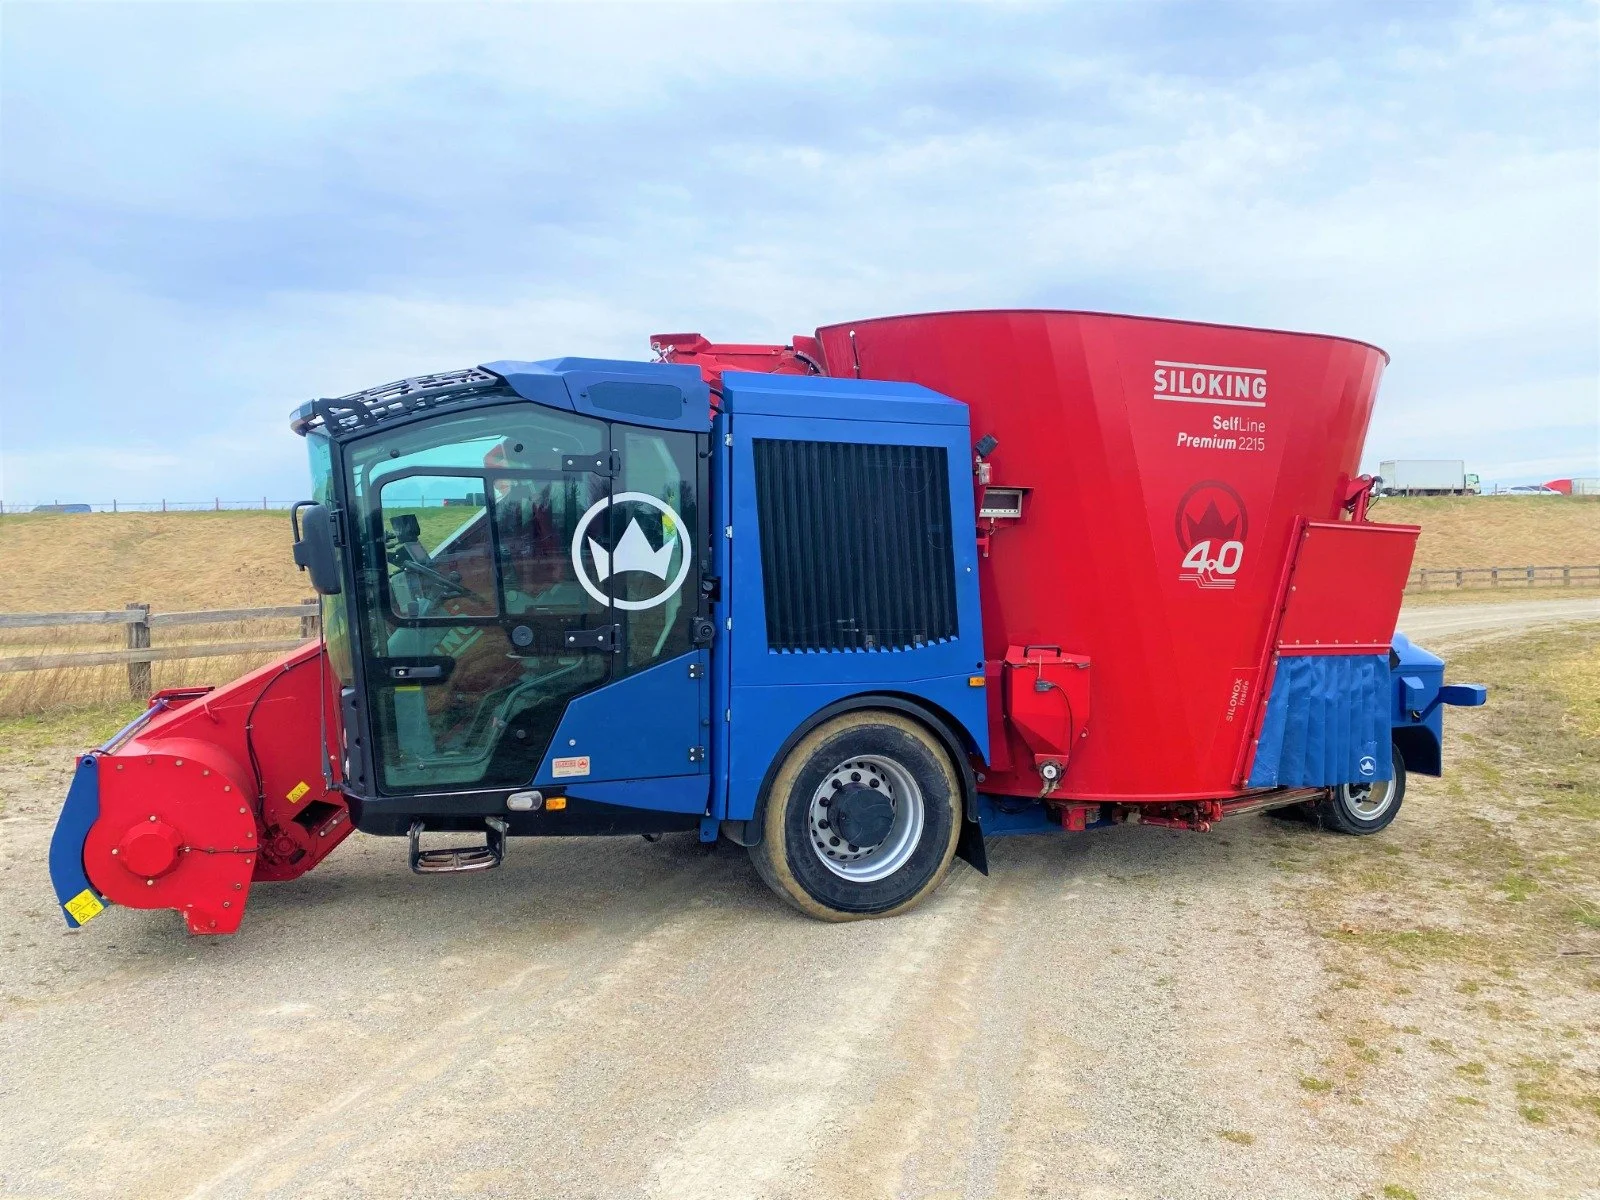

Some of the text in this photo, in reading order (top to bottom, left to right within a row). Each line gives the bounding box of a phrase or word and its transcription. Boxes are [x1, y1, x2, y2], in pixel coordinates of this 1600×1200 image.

[1154, 369, 1267, 399] SILOKING
[1213, 415, 1266, 433] SelfLine
[1177, 432, 1265, 452] Premium 2215
[1226, 678, 1243, 722] SILONOX
[1238, 680, 1249, 706] inside
